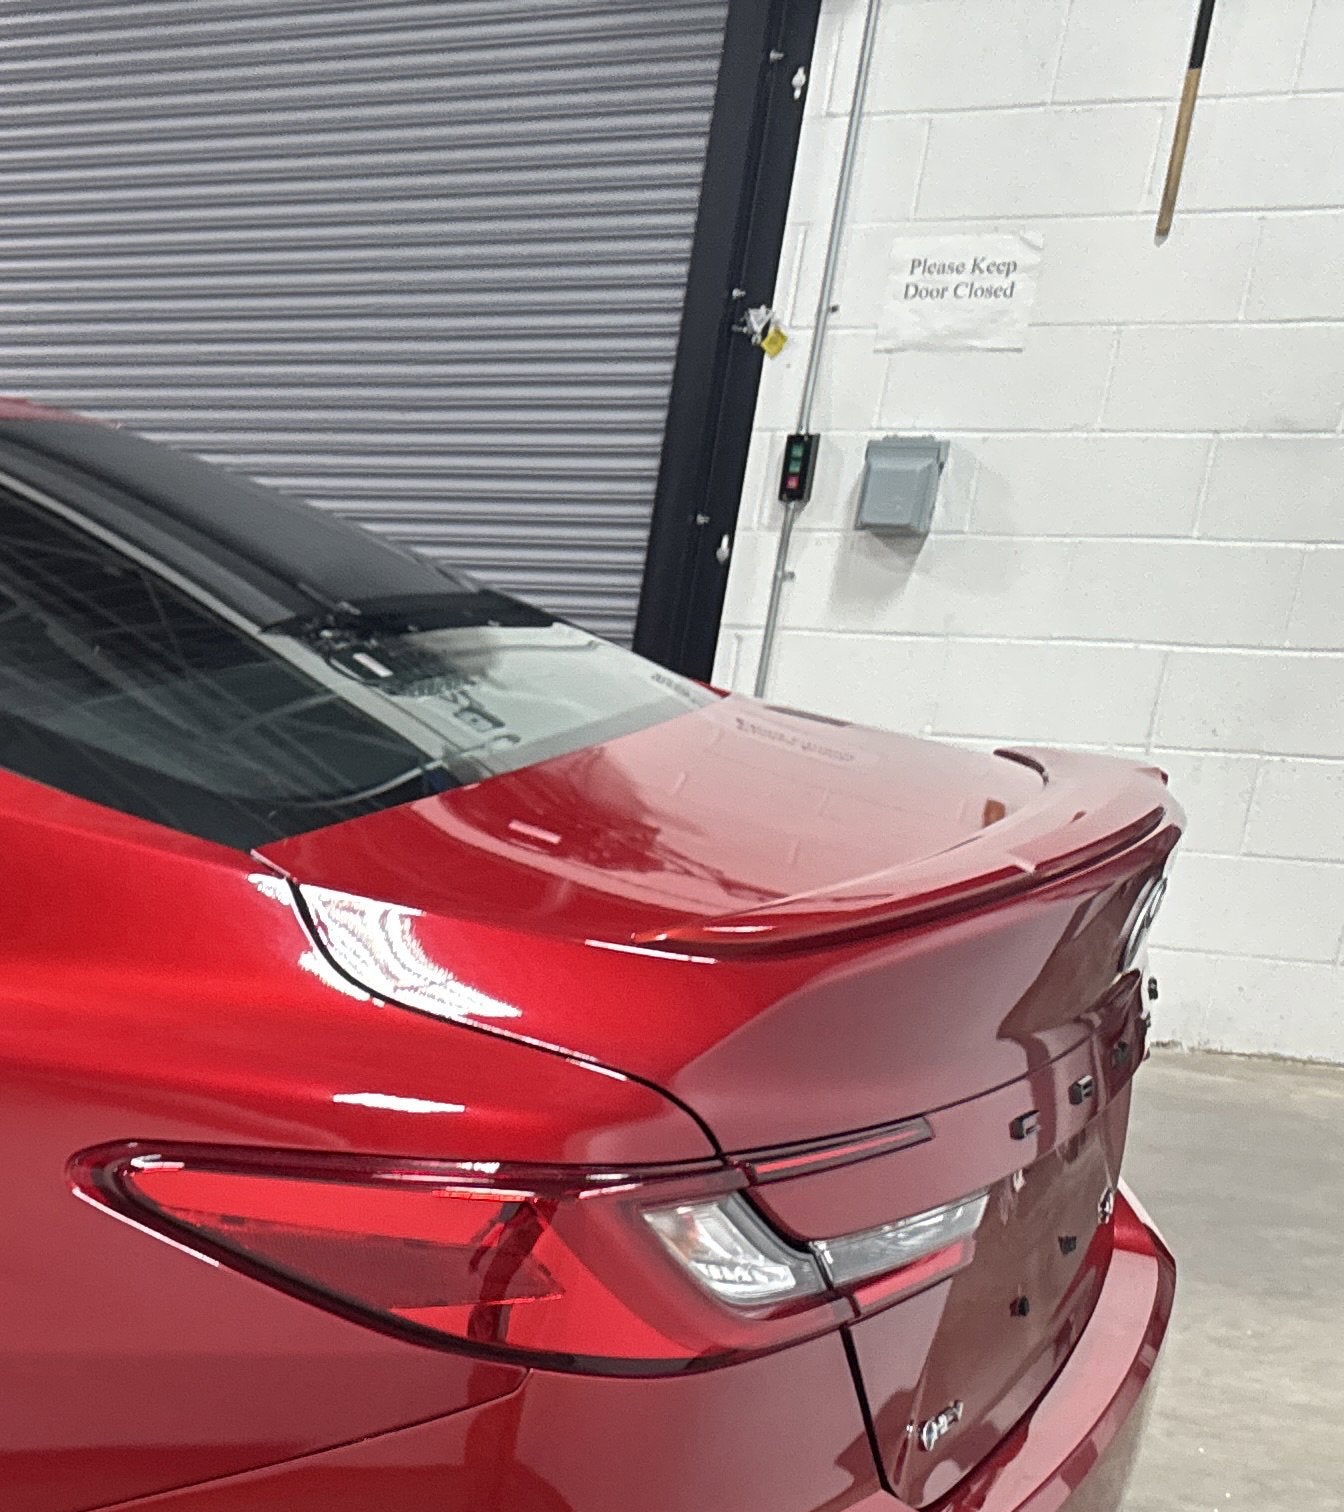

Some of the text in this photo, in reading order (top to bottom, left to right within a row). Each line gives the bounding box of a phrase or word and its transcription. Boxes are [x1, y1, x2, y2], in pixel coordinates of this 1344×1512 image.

[909, 256, 1018, 279] Please Keep
[903, 280, 1015, 300] Door Closed
